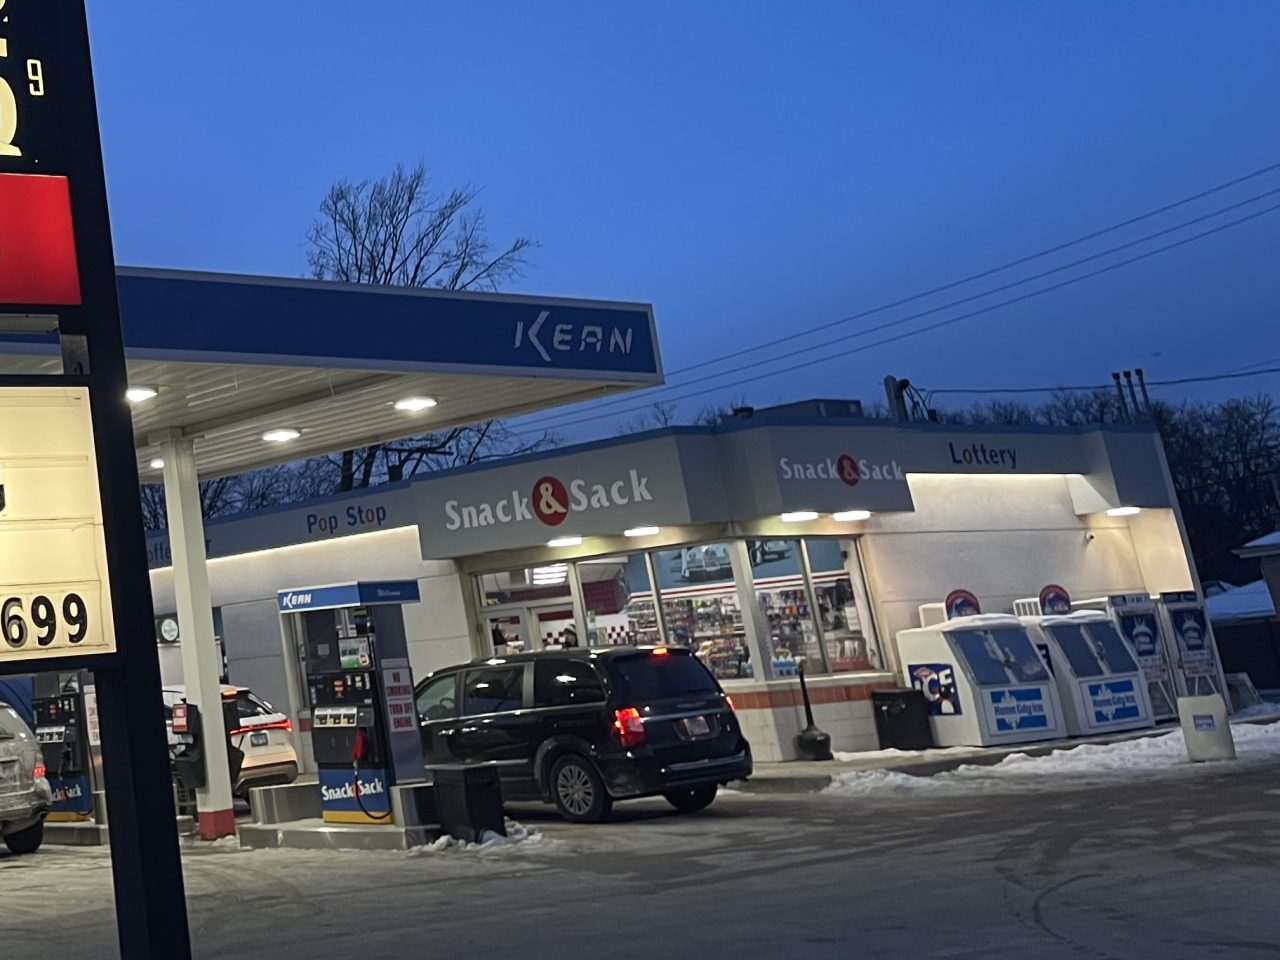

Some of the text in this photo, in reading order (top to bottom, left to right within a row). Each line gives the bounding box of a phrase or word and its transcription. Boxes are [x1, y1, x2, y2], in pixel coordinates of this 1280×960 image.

[513, 310, 633, 362] KEAN
[948, 442, 1017, 470] Lottery
[444, 490, 533, 531] Snack
[570, 468, 653, 512] Sack
[306, 503, 387, 534] Pop Stop
[283, 592, 312, 609] KEAN
[321, 777, 384, 802] Snack Sack
